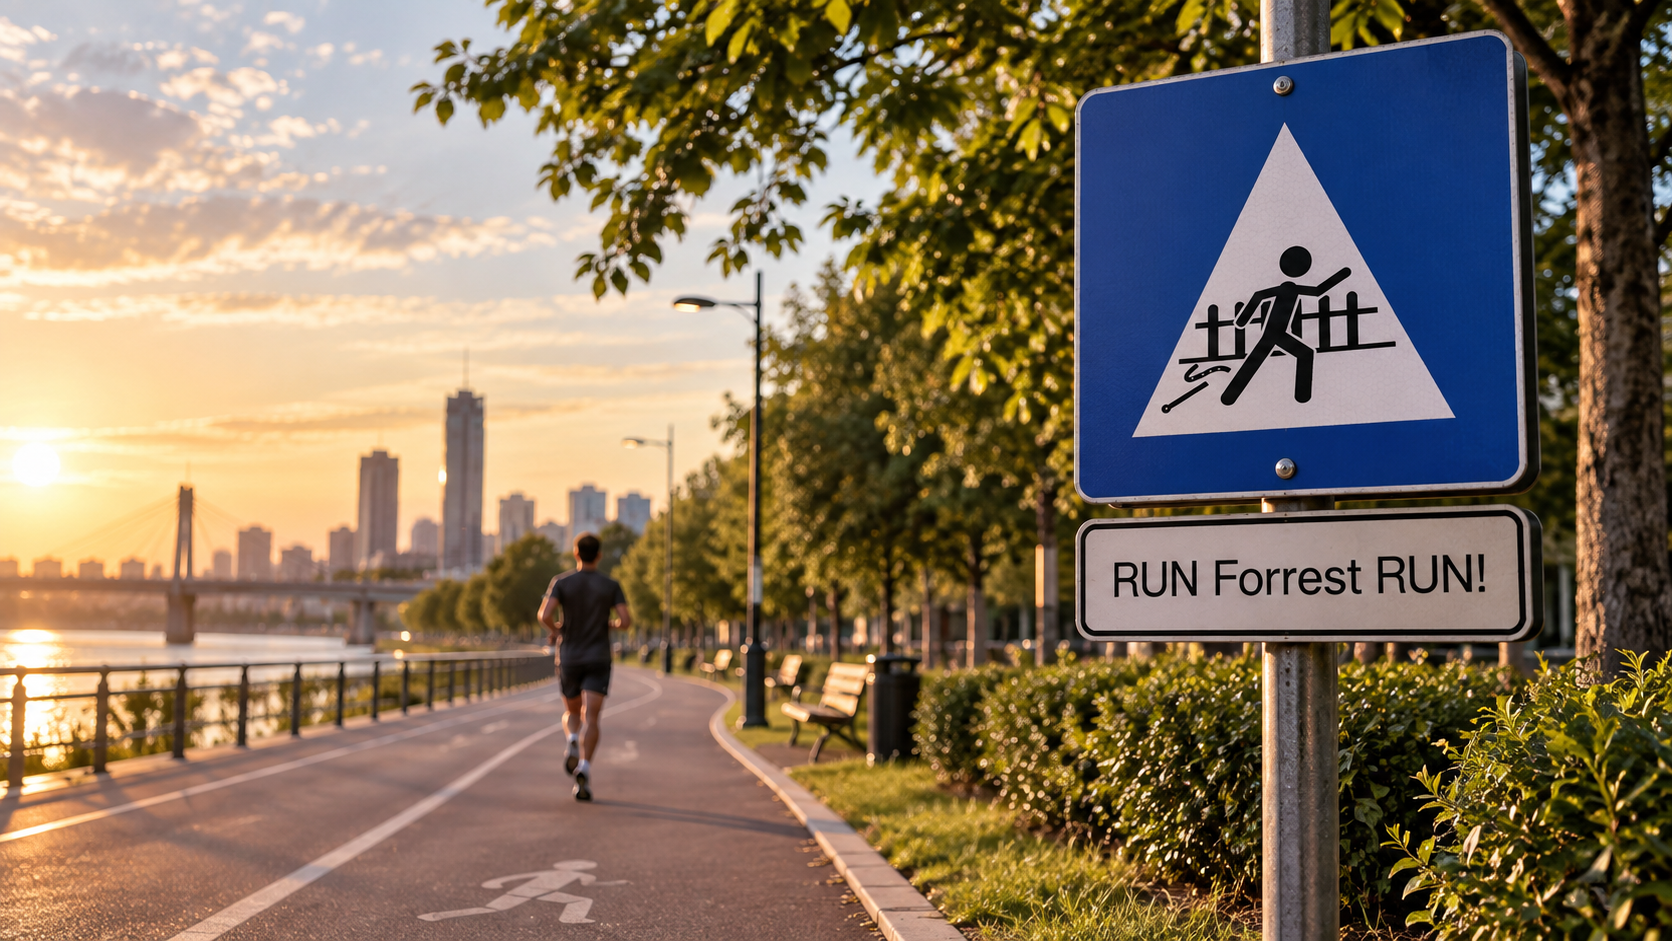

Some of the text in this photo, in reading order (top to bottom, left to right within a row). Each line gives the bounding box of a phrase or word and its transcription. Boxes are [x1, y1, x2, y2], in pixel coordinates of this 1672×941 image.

[1113, 553, 1486, 598] RUN Forrest RUN!
